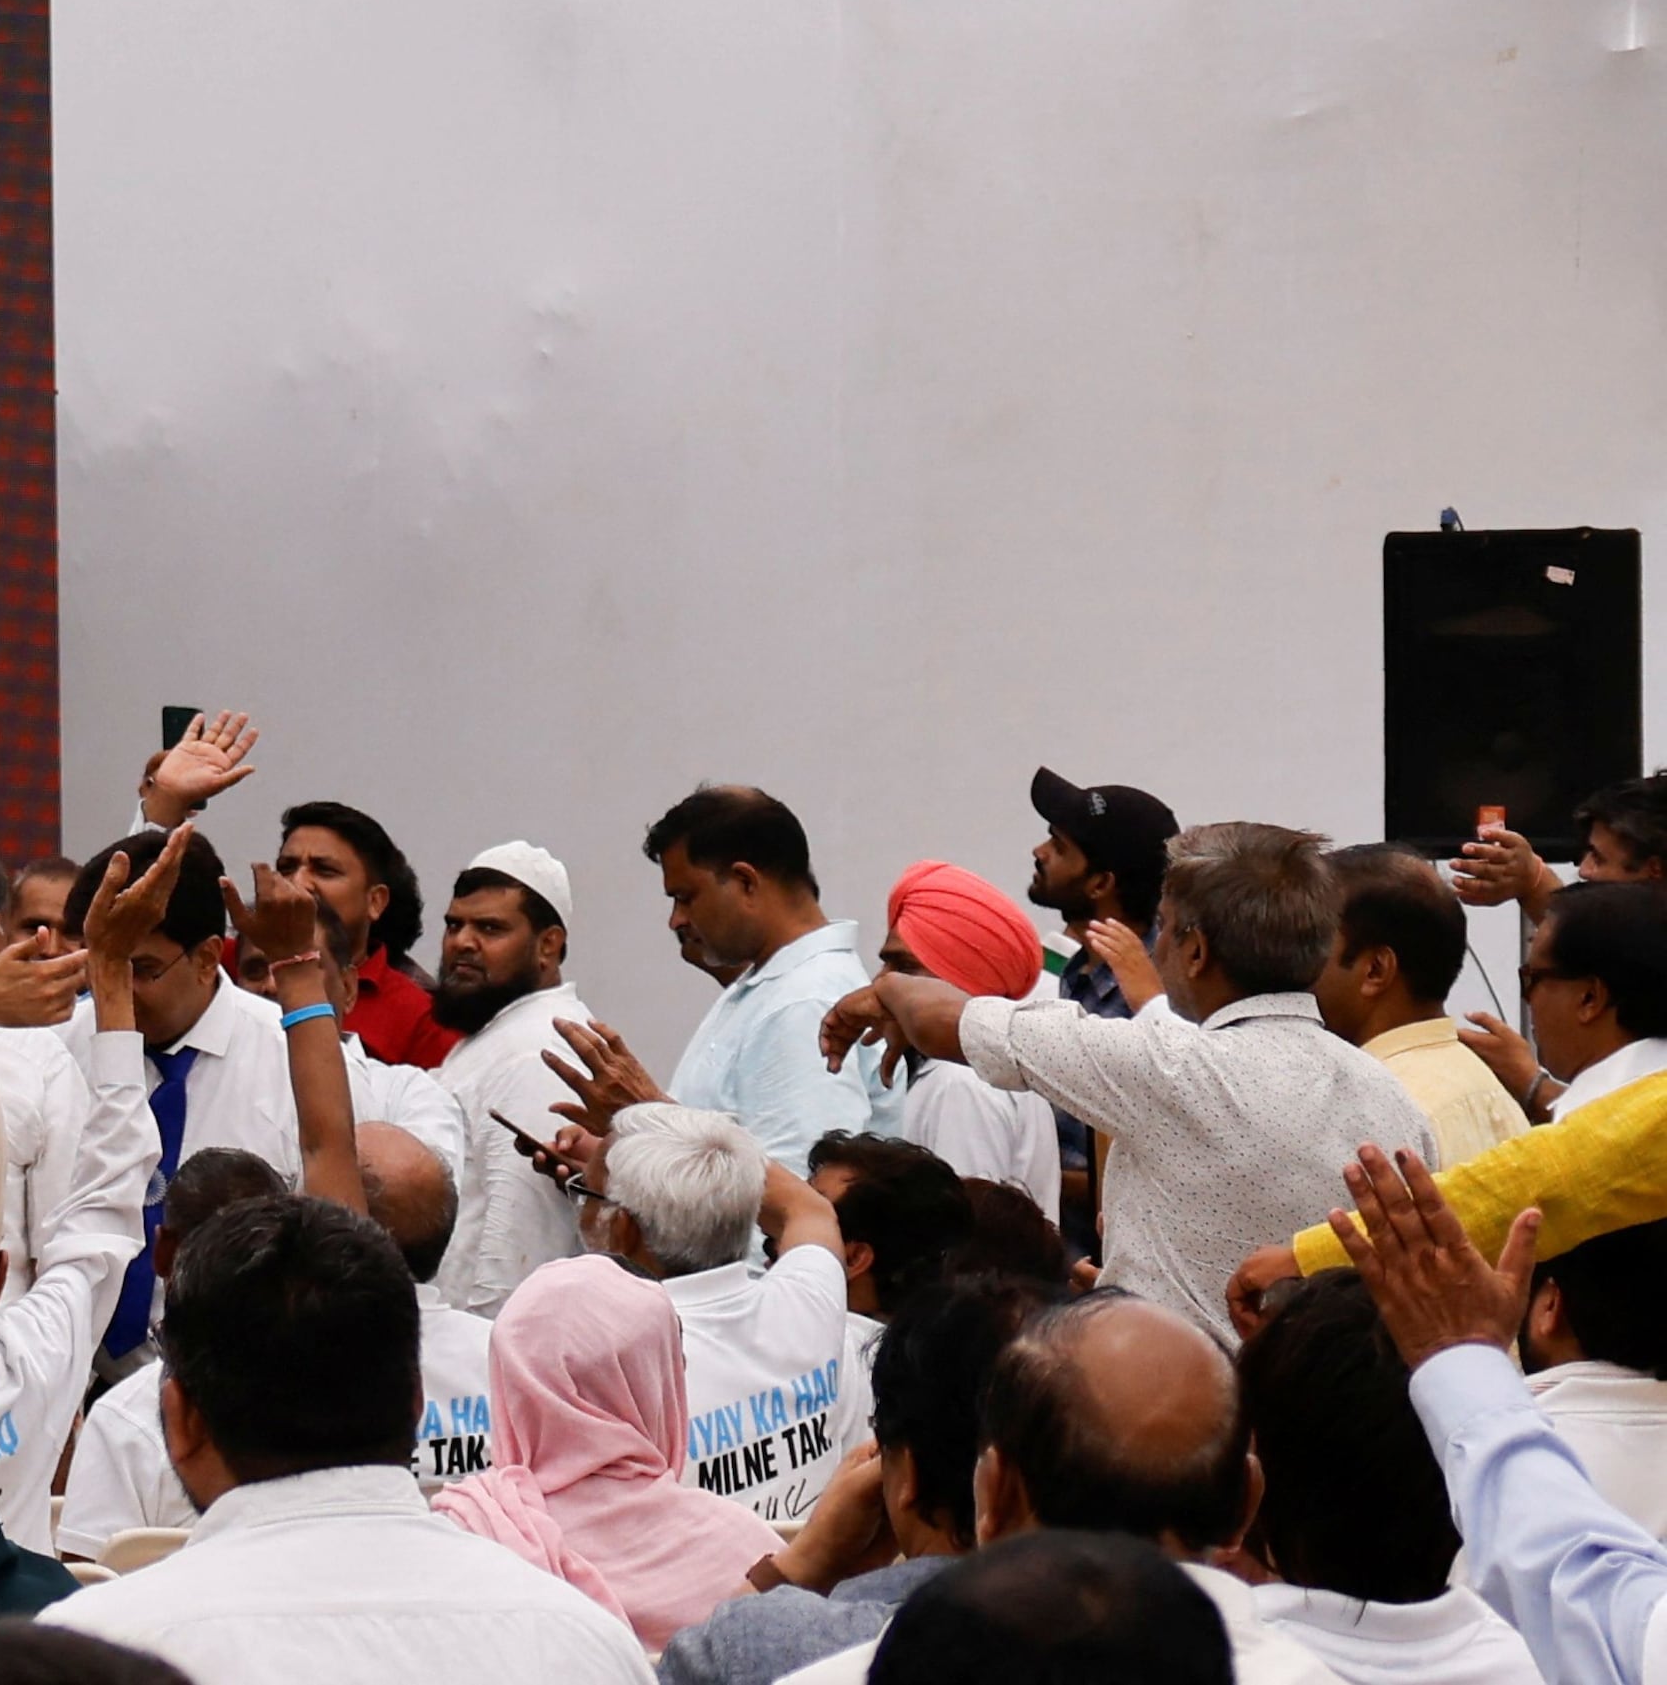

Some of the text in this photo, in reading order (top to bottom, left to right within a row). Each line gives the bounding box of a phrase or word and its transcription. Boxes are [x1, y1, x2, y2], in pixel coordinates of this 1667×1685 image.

[451, 1394, 491, 1436] HA
[749, 1386, 789, 1437] KA
[429, 1434, 493, 1476] TAK.
[698, 1412, 833, 1496] MILNE TAK.
